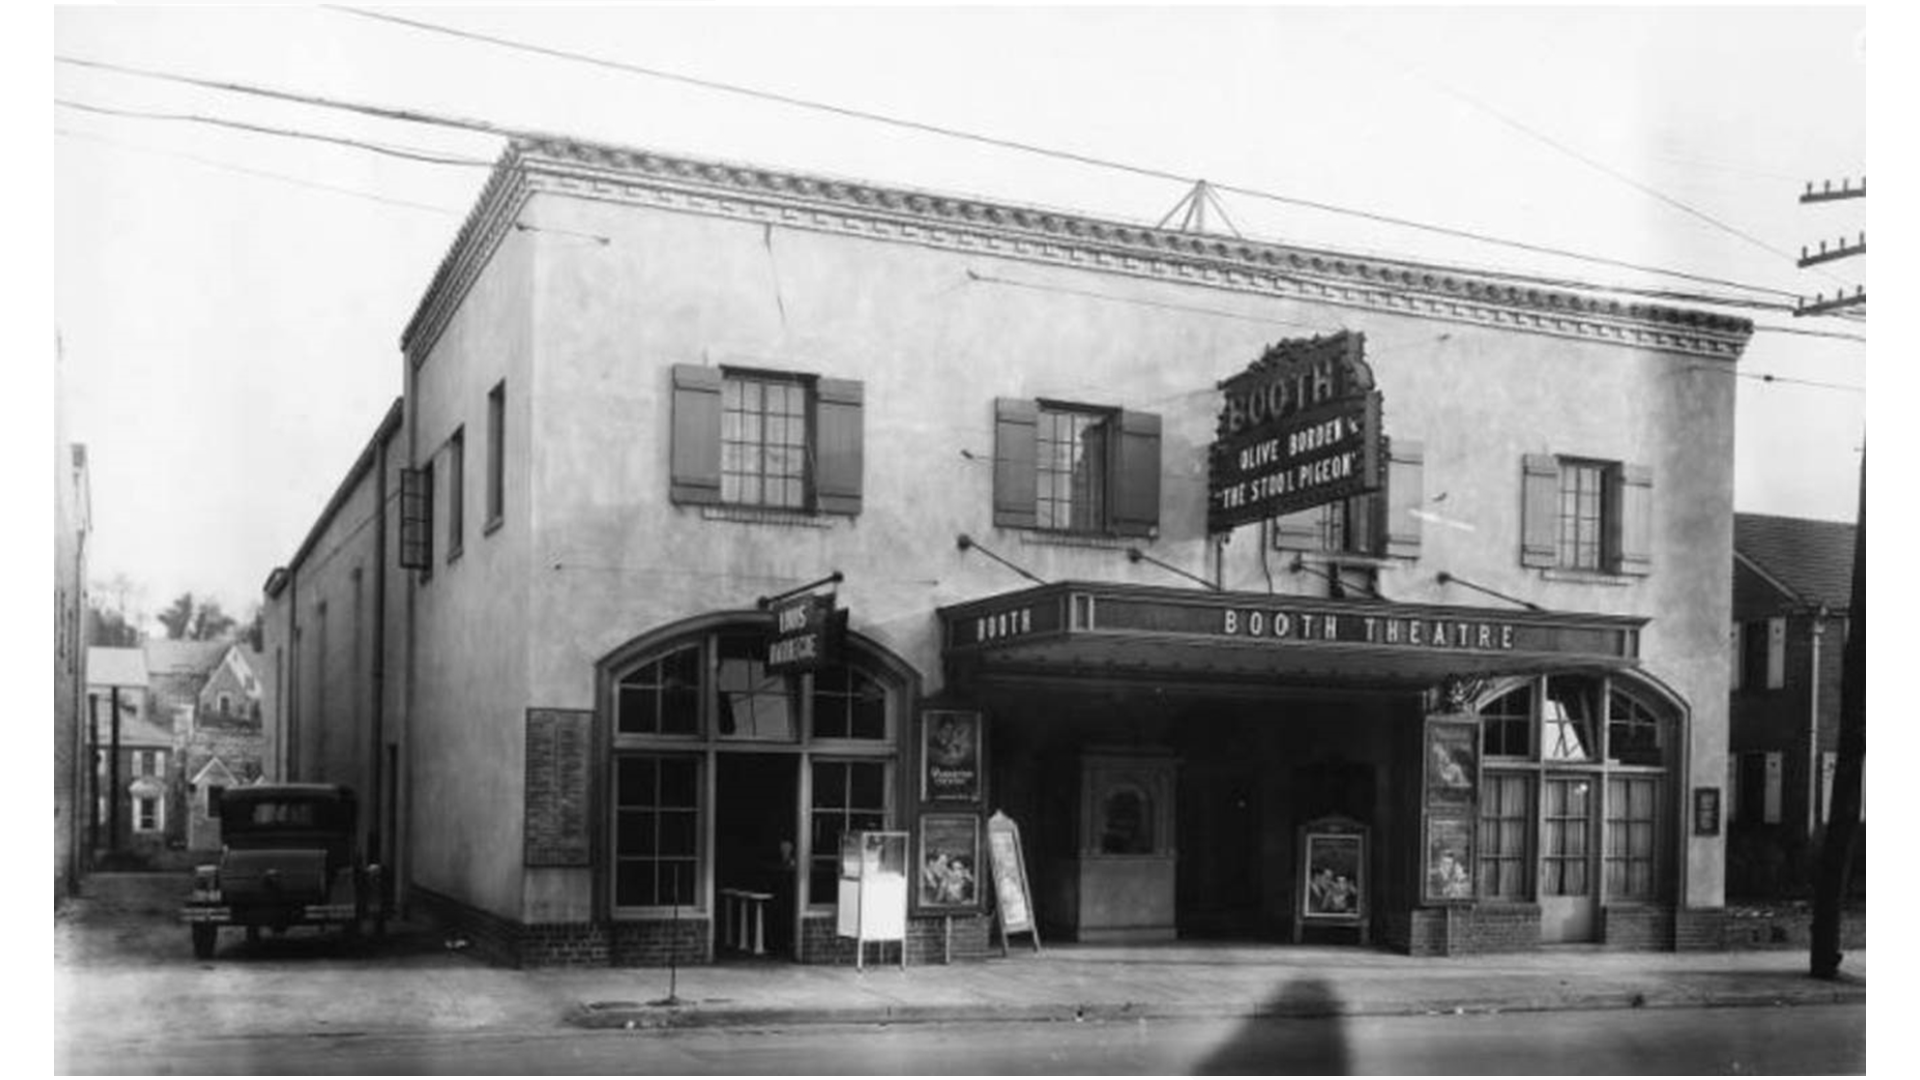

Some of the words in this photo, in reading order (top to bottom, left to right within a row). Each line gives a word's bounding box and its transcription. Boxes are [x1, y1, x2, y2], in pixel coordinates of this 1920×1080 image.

[1229, 359, 1333, 432] BOOTH
[1239, 440, 1279, 471] OLIVE
[1289, 416, 1342, 456] BORDEN
[1251, 470, 1295, 502] STOOL
[978, 608, 1031, 642] BOOTH
[1224, 609, 1337, 640] BOOTH
[1364, 617, 1513, 648] THEATRE
